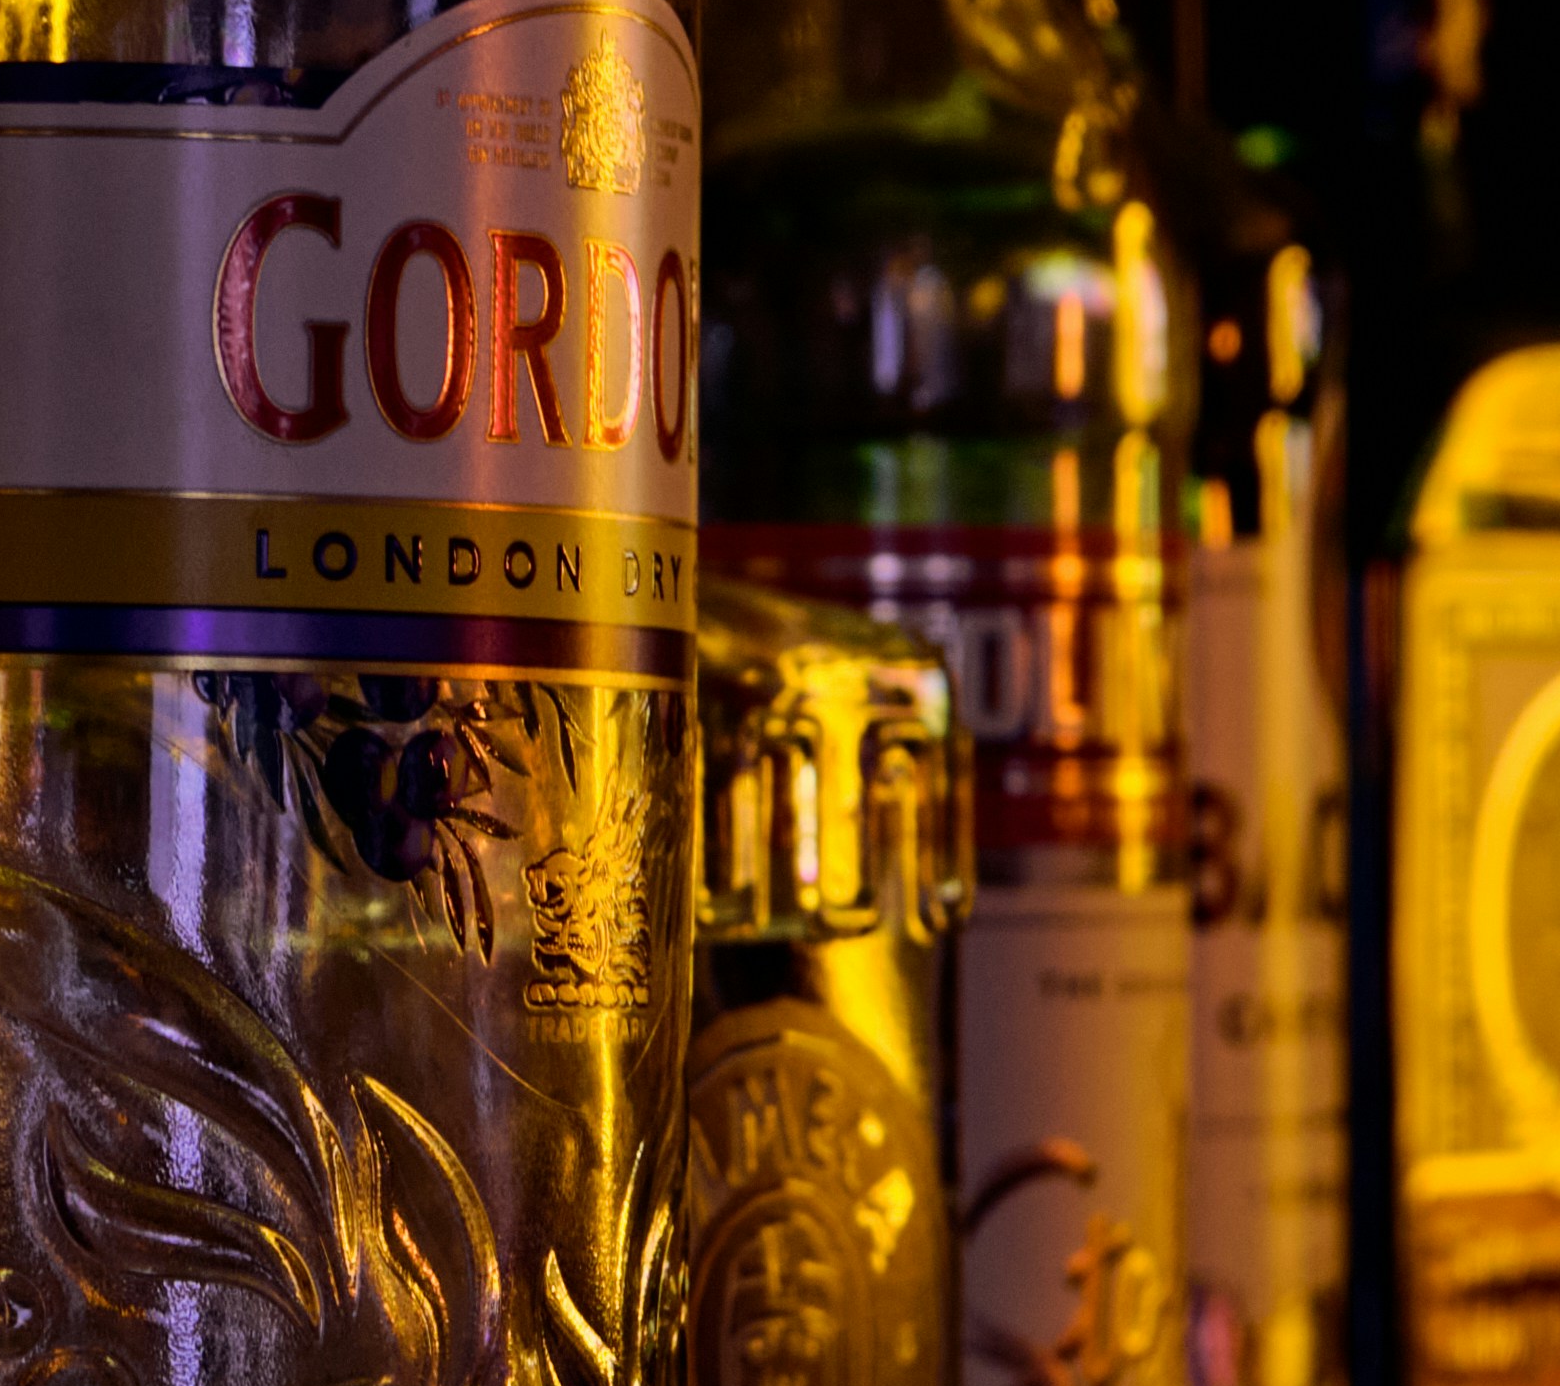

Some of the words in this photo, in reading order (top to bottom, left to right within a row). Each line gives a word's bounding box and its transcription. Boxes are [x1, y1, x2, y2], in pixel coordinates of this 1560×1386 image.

[212, 189, 698, 465] GORDO
[254, 528, 582, 594] LONDON
[622, 549, 683, 603] DRY
